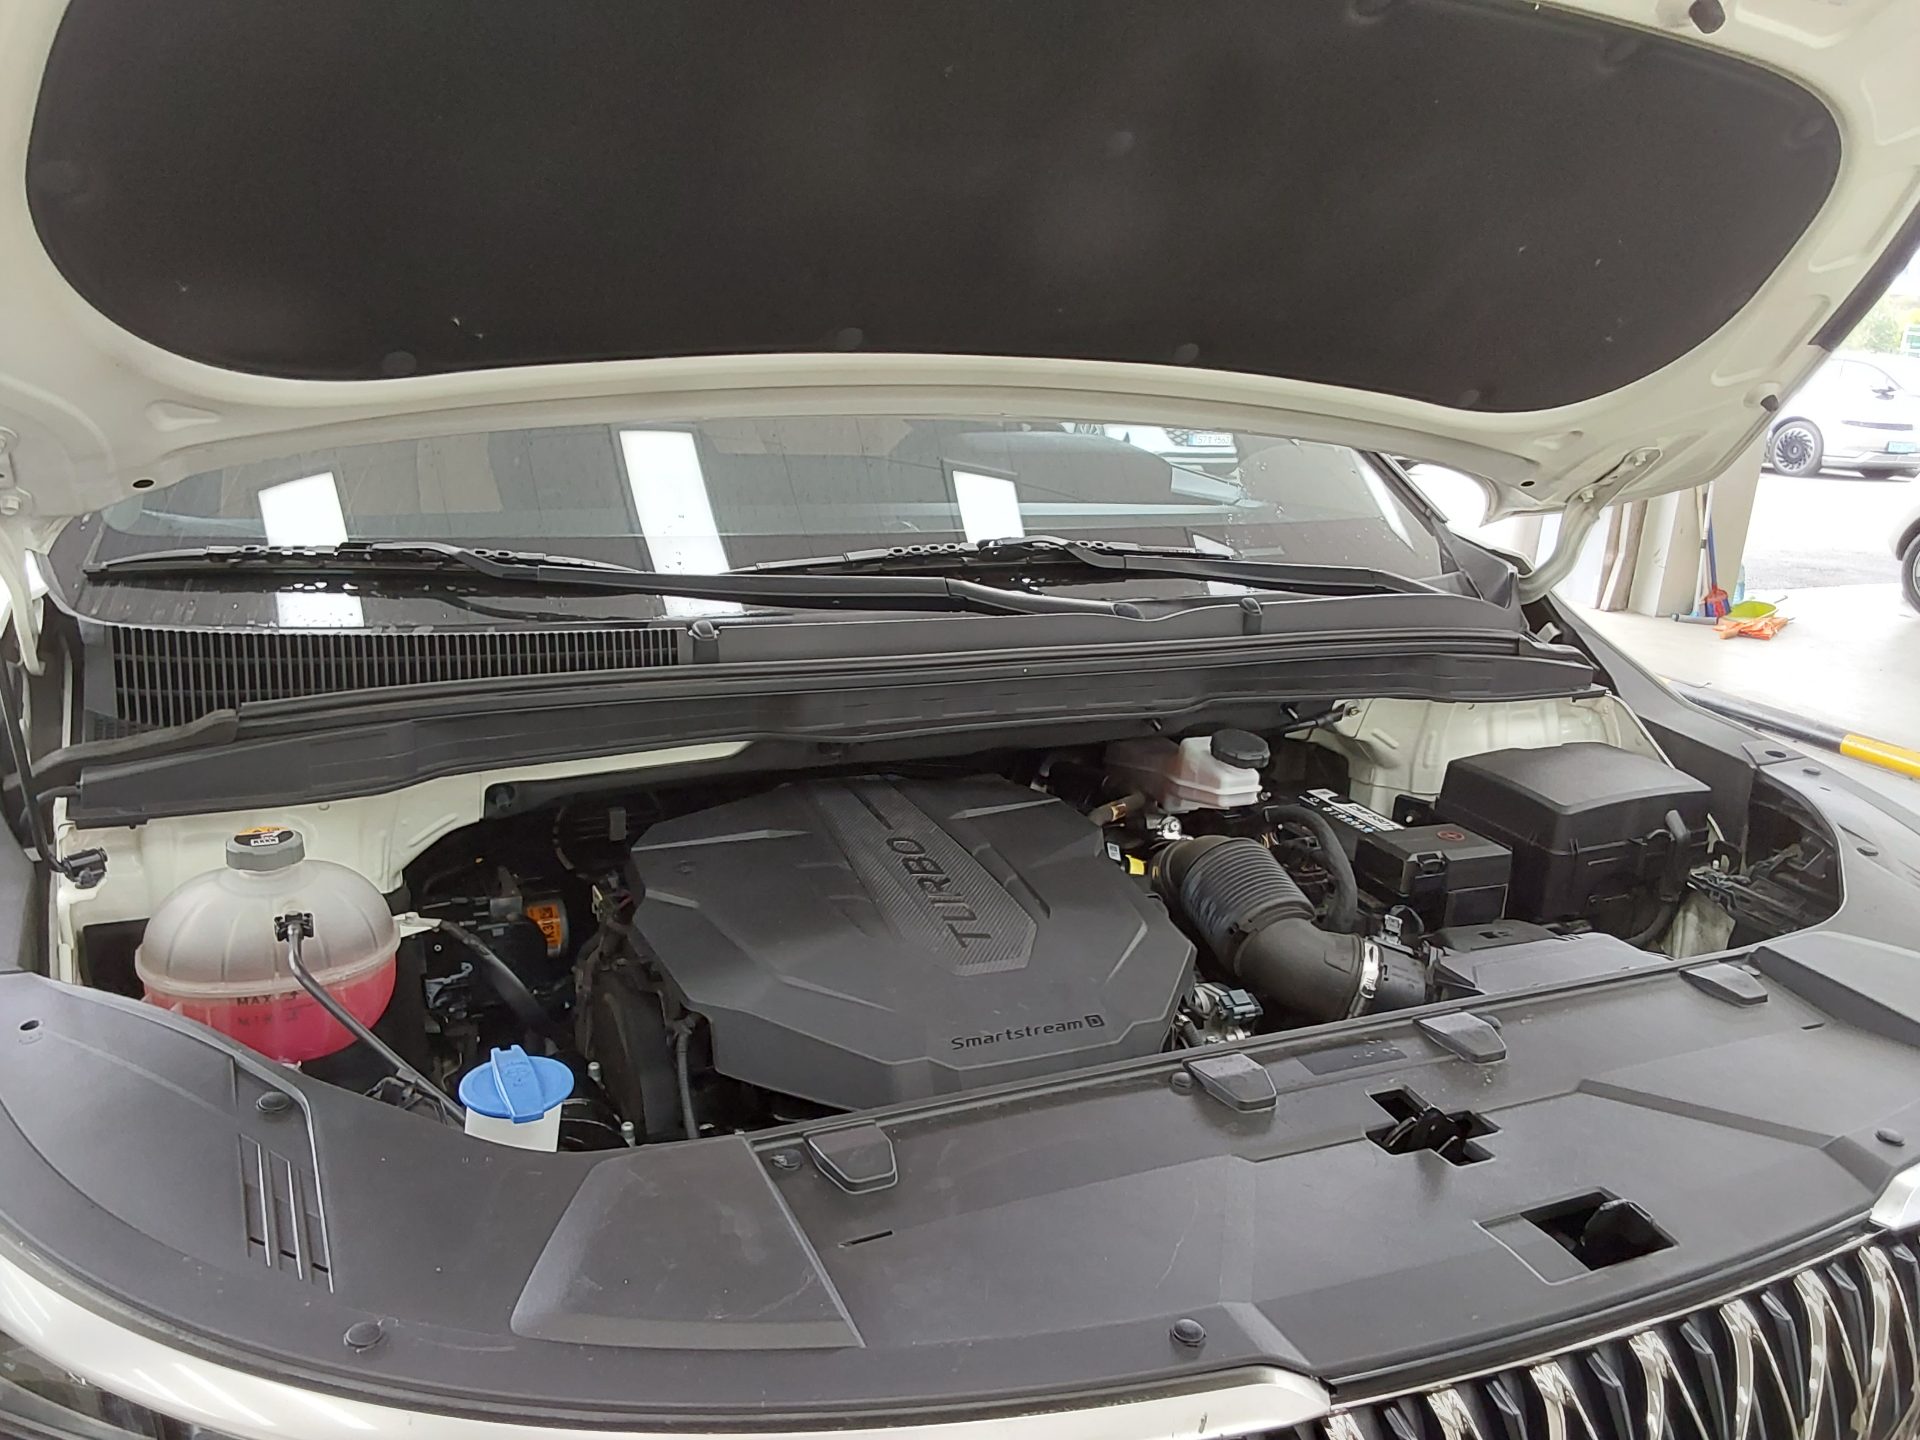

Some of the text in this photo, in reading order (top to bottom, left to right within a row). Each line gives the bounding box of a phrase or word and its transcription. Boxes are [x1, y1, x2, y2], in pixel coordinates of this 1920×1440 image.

[886, 838, 991, 948] TURBO
[236, 994, 272, 1006] MAX
[950, 1020, 1083, 1050] Smartstream
